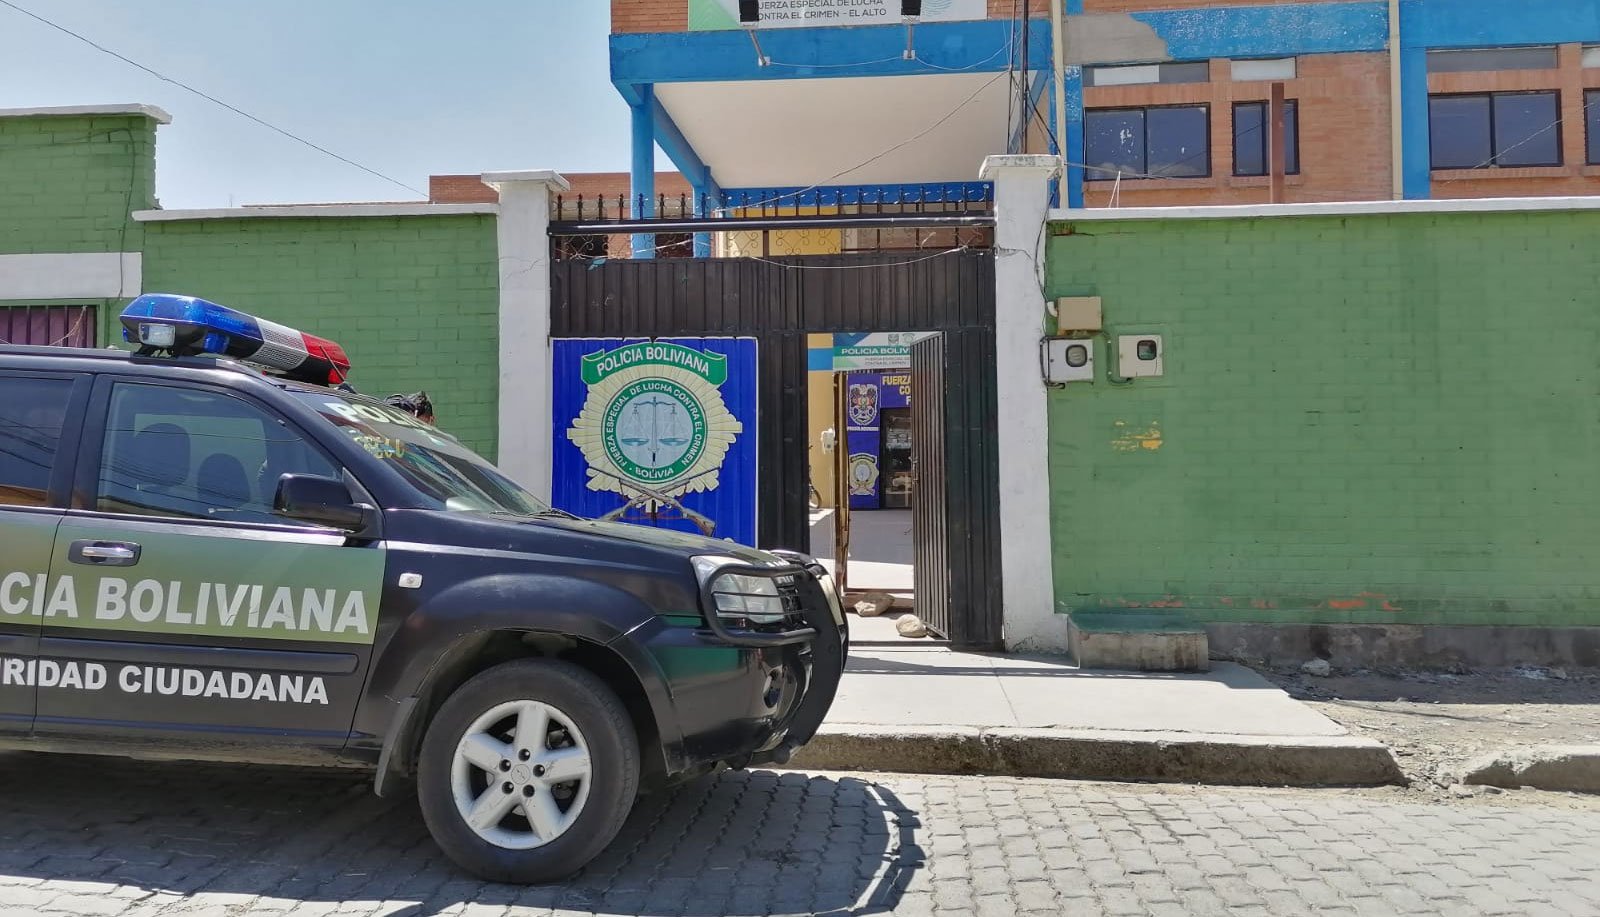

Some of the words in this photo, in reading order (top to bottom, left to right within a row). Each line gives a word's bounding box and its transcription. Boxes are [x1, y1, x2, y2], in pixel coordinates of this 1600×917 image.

[759, 1, 789, 10] UERZA
[790, 0, 835, 8] ESPECIAL
[759, 12, 789, 20] ONTRA
[804, 10, 840, 18] CRIMEN
[849, 9, 861, 17] EL
[862, 8, 887, 16] ALTO
[841, 347, 879, 355] POLICIA
[597, 347, 643, 377] POLICIA
[636, 346, 709, 376] BOLIVIANA
[630, 385, 641, 396] DE
[643, 383, 673, 394] LUCHA
[899, 386, 911, 395] CO
[673, 388, 700, 419] CONTRA
[606, 395, 628, 433] ESPECIAL
[694, 421, 703, 432] EL
[606, 434, 627, 467] FUERZA
[681, 433, 702, 466] CRIMEN
[635, 467, 674, 479] BOLIVIA
[95, 577, 369, 634] BOLIVIANA
[0, 656, 107, 690] RIDAD
[118, 665, 329, 705] CIUDADANA
